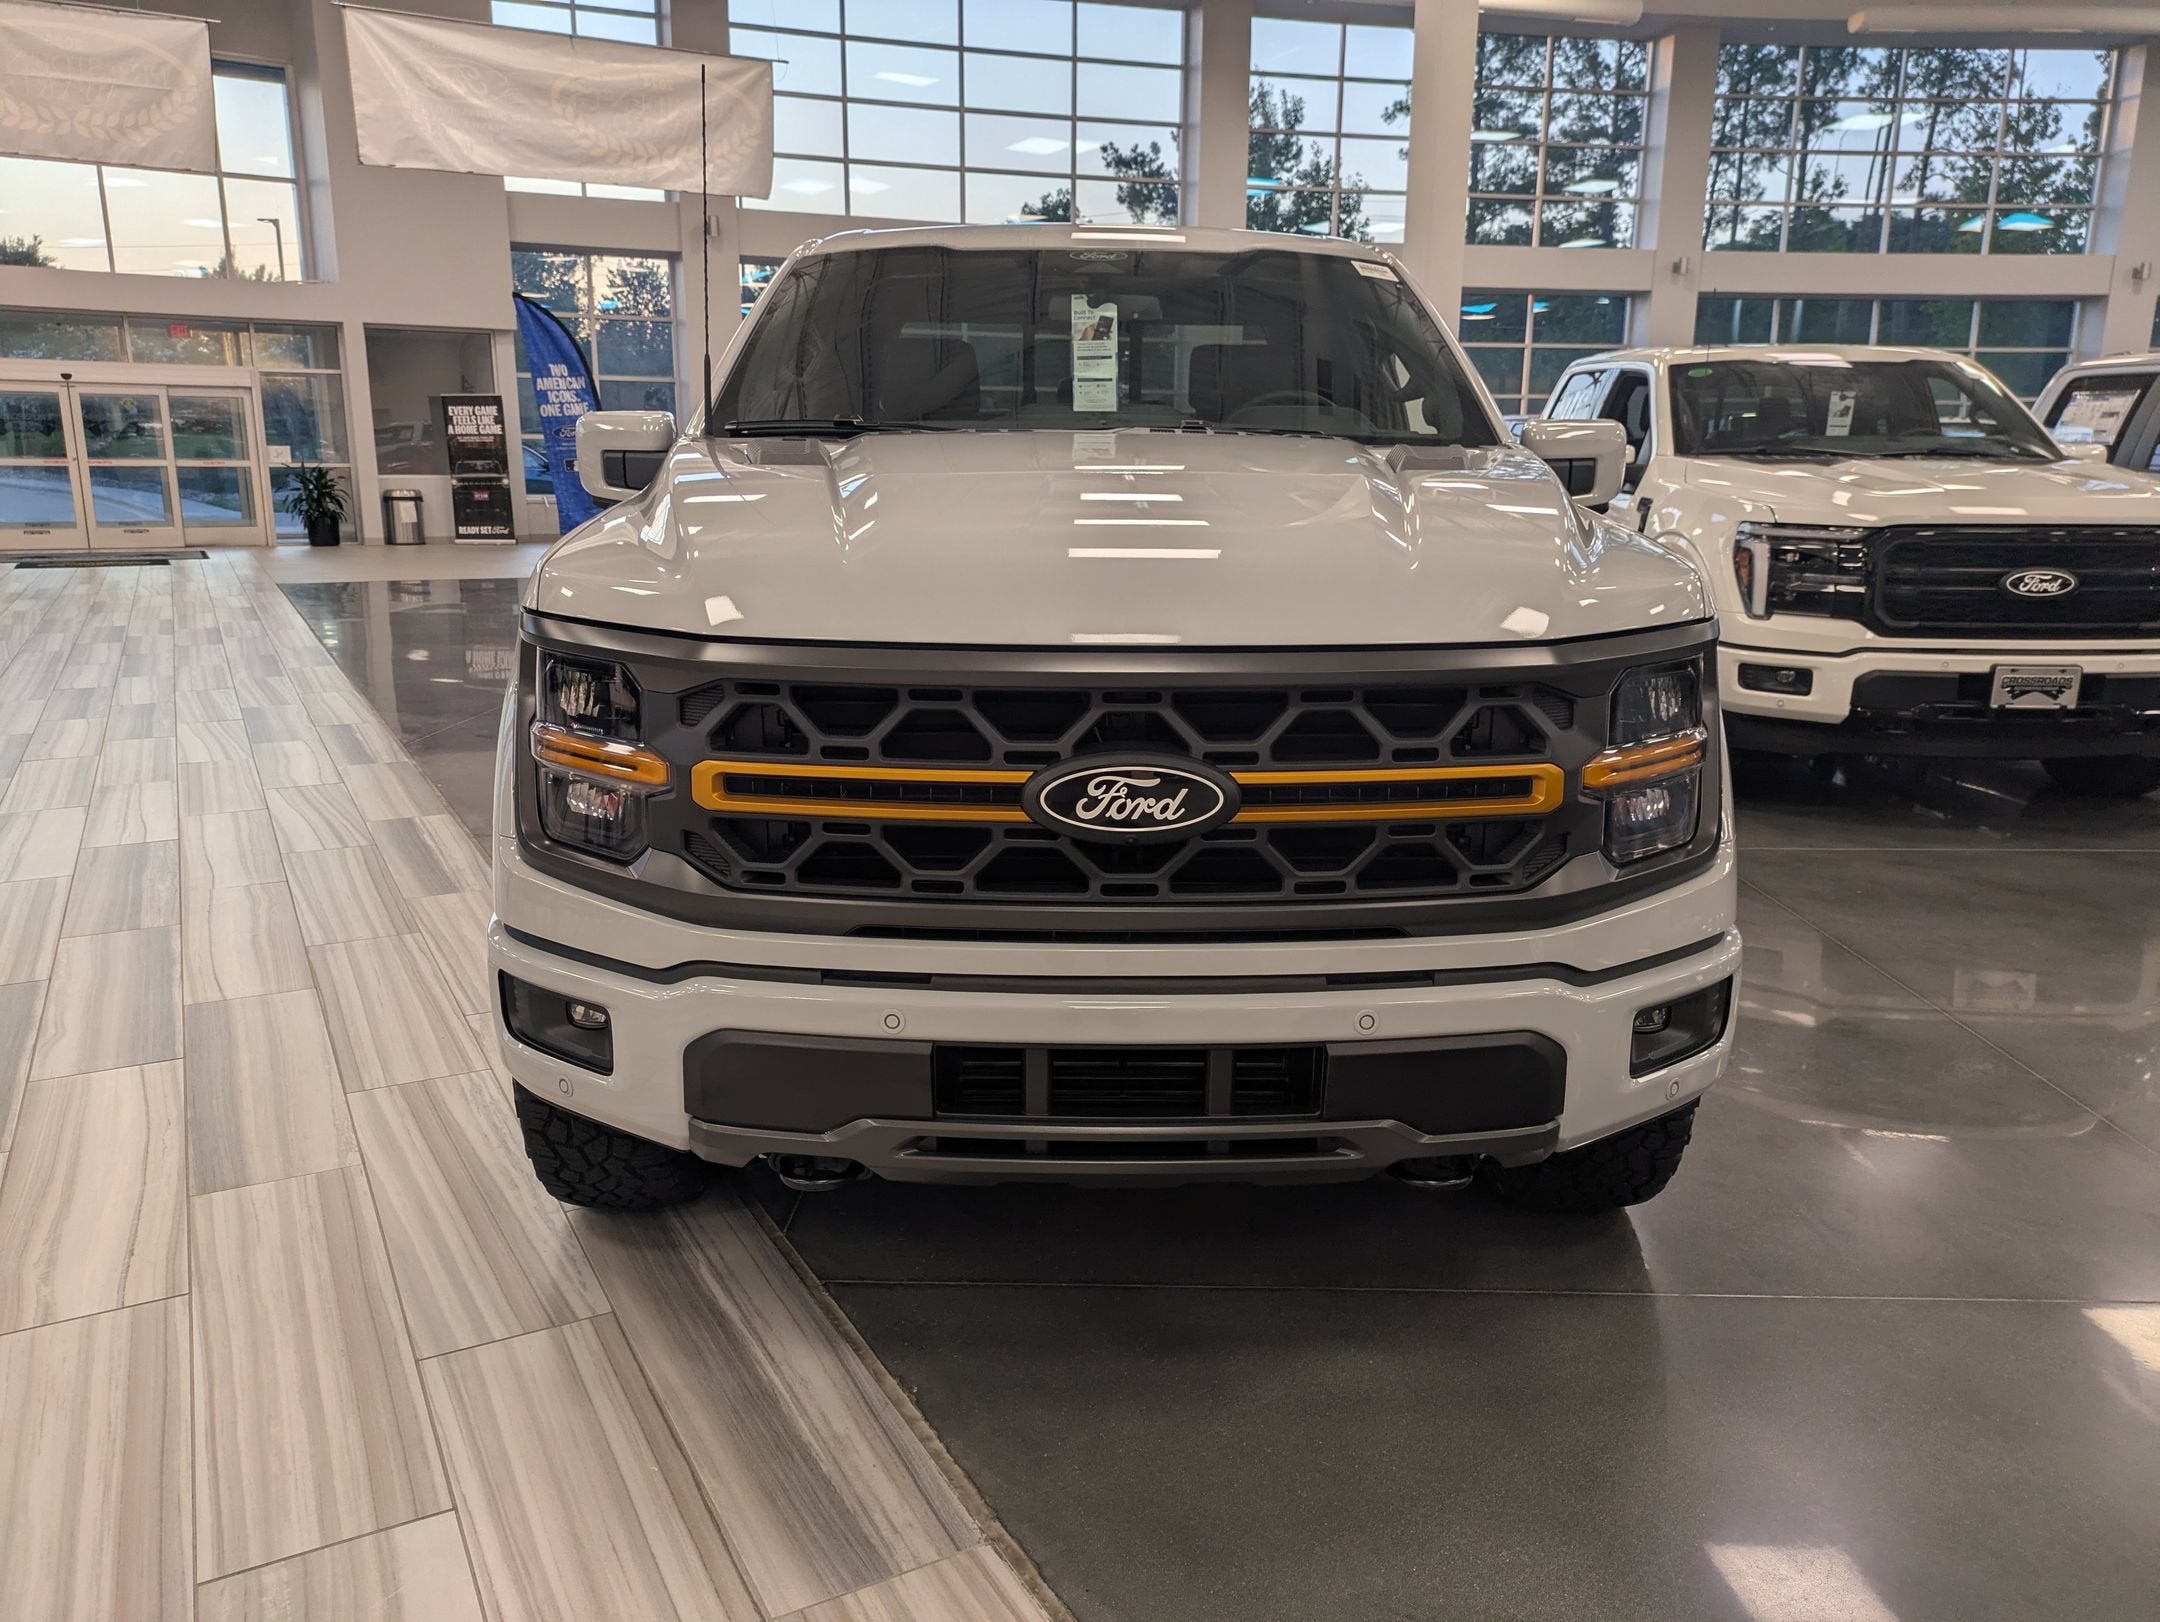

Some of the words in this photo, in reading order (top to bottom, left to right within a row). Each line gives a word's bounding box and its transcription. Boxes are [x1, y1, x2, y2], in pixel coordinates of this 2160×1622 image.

[548, 363, 568, 377] TWO
[537, 376, 586, 391] AMERICAN
[448, 405, 474, 416] EVERY
[475, 405, 499, 416] GAME
[540, 404, 563, 417] ONE
[453, 415, 477, 425] FEELS
[477, 415, 496, 425] LIKE
[448, 424, 455, 435] A
[454, 424, 479, 435] HOME
[479, 424, 503, 435] GAME
[458, 526, 479, 535] READY
[480, 526, 492, 535] SET
[2019, 574, 2063, 592] Ford
[2001, 676, 2074, 689] CROSSROADS
[1075, 775, 1189, 821] Ford
